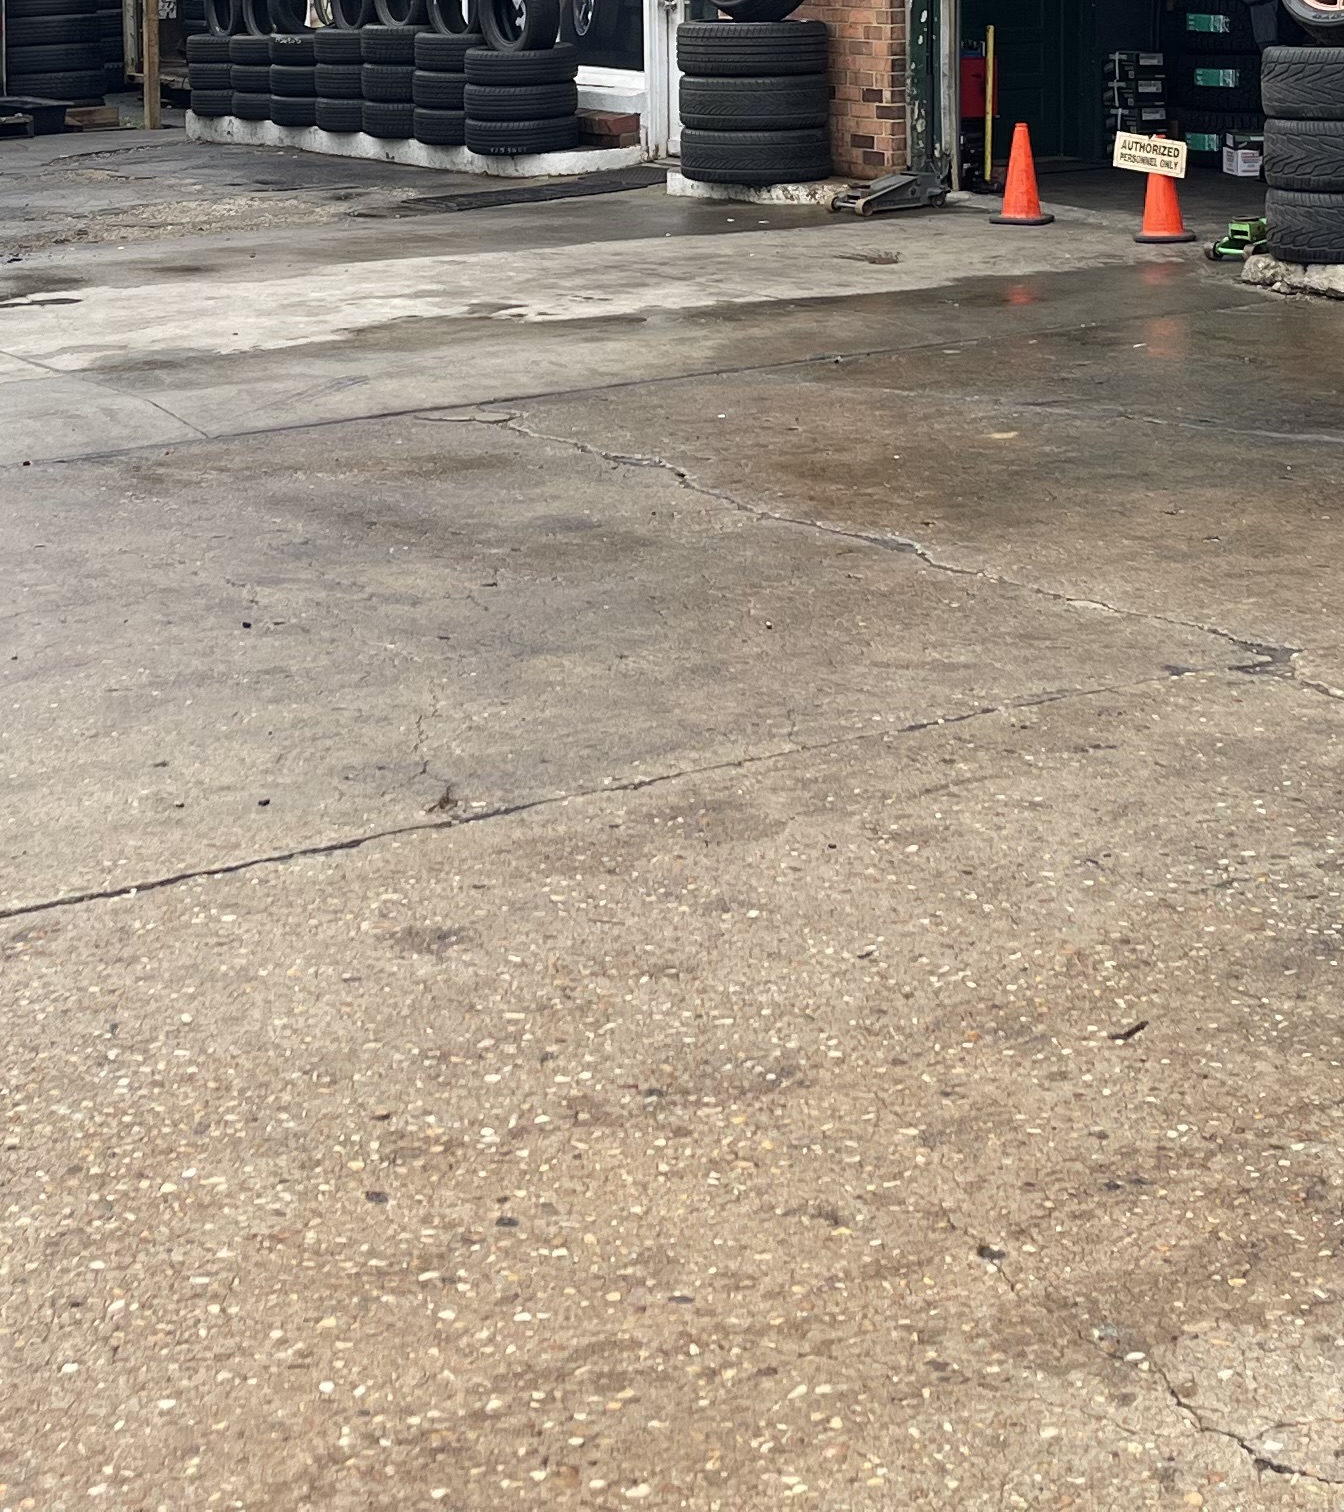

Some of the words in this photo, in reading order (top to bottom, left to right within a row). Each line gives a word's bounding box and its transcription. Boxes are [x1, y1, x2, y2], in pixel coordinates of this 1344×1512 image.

[1121, 139, 1180, 158] AUTHORIZED
[1120, 152, 1157, 167] PERSONNEL
[1160, 159, 1179, 170] ONLY
